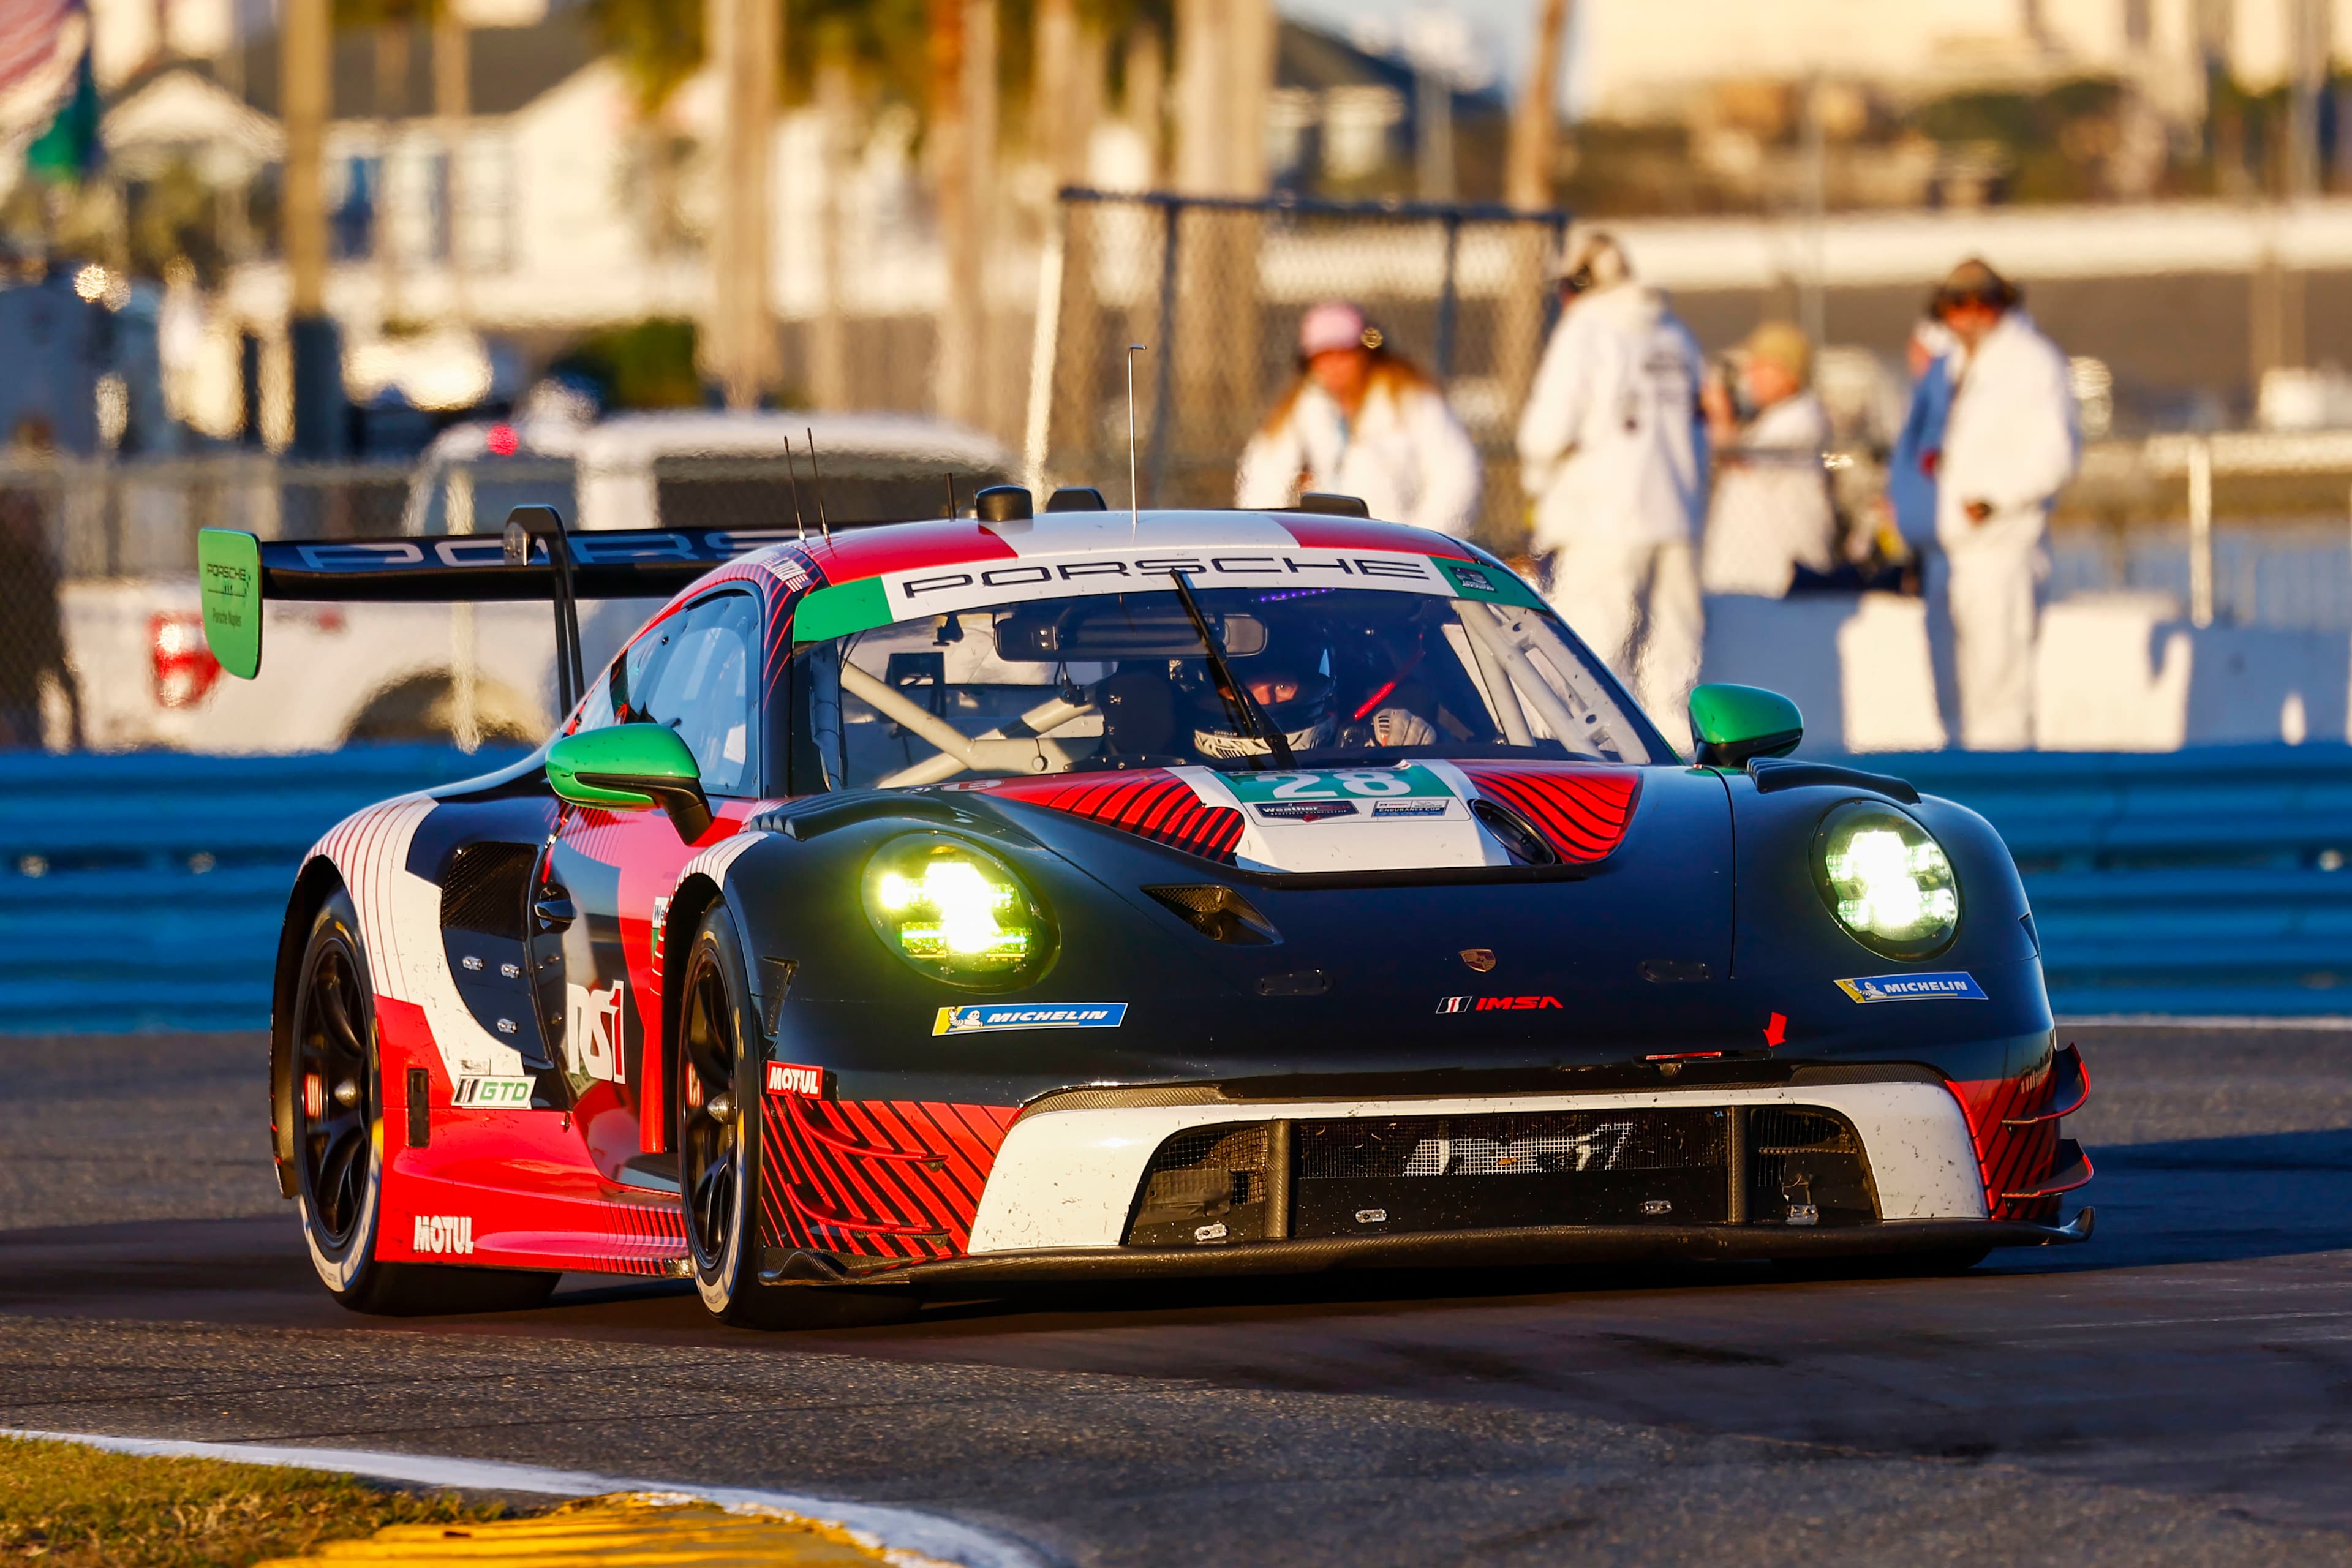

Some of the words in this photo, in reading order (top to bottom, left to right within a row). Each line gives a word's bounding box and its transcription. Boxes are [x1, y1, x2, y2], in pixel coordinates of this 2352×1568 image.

[207, 564, 246, 581] PORSCHE
[902, 557, 1430, 599] PORSCHE
[1255, 771, 1411, 799] 28
[1883, 981, 1969, 993] MICHELIN
[1475, 995, 1564, 1011] IMSA
[987, 1011, 1109, 1023] MICHELIN
[769, 1066, 819, 1095] MOTUL
[479, 1082, 529, 1101] GTD
[413, 1215, 474, 1254] MOTUL
